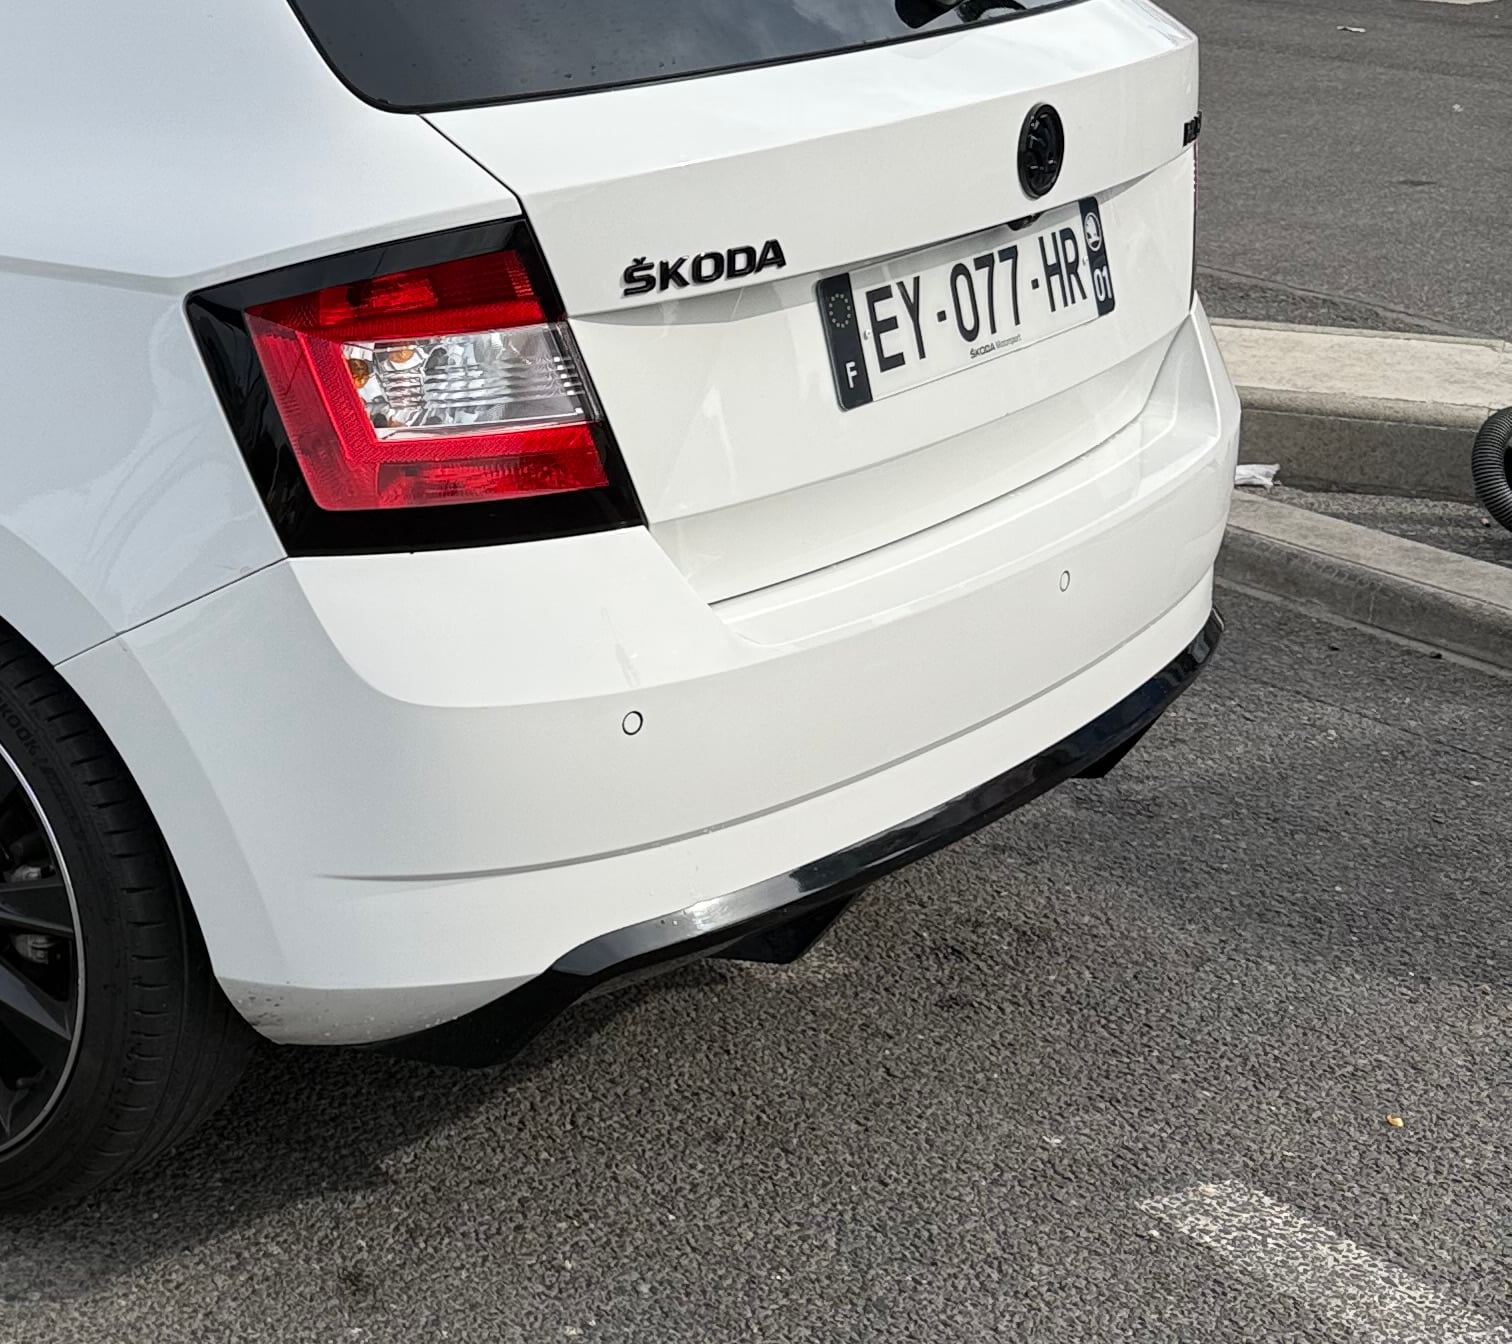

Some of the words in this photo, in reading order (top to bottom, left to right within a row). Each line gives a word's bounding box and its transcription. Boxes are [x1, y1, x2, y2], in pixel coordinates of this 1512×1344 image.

[622, 239, 787, 297] ŠKODA
[1093, 265, 1113, 302] 01
[866, 227, 1088, 373] EY-077-HR
[845, 361, 858, 389] F
